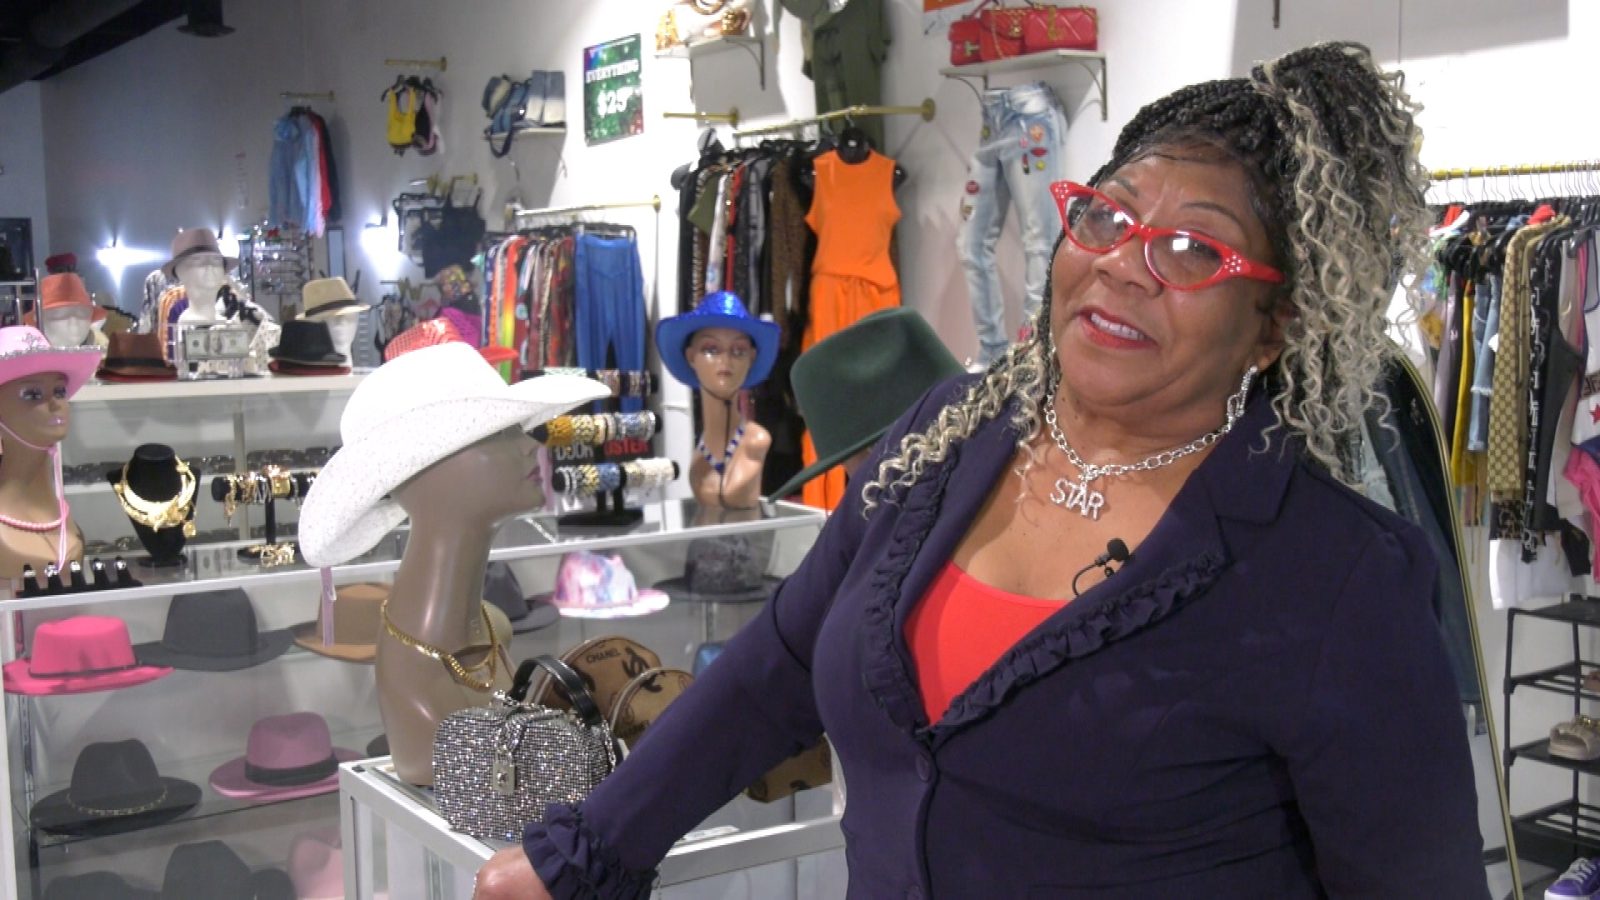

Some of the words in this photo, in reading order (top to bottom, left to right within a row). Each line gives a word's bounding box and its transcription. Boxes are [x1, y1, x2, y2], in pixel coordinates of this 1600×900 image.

[586, 59, 639, 83] EVERYTHING
[597, 86, 634, 119] $25
[603, 437, 649, 456] USTER
[1049, 478, 1104, 520] STAR
[587, 649, 620, 663] CHANEL
